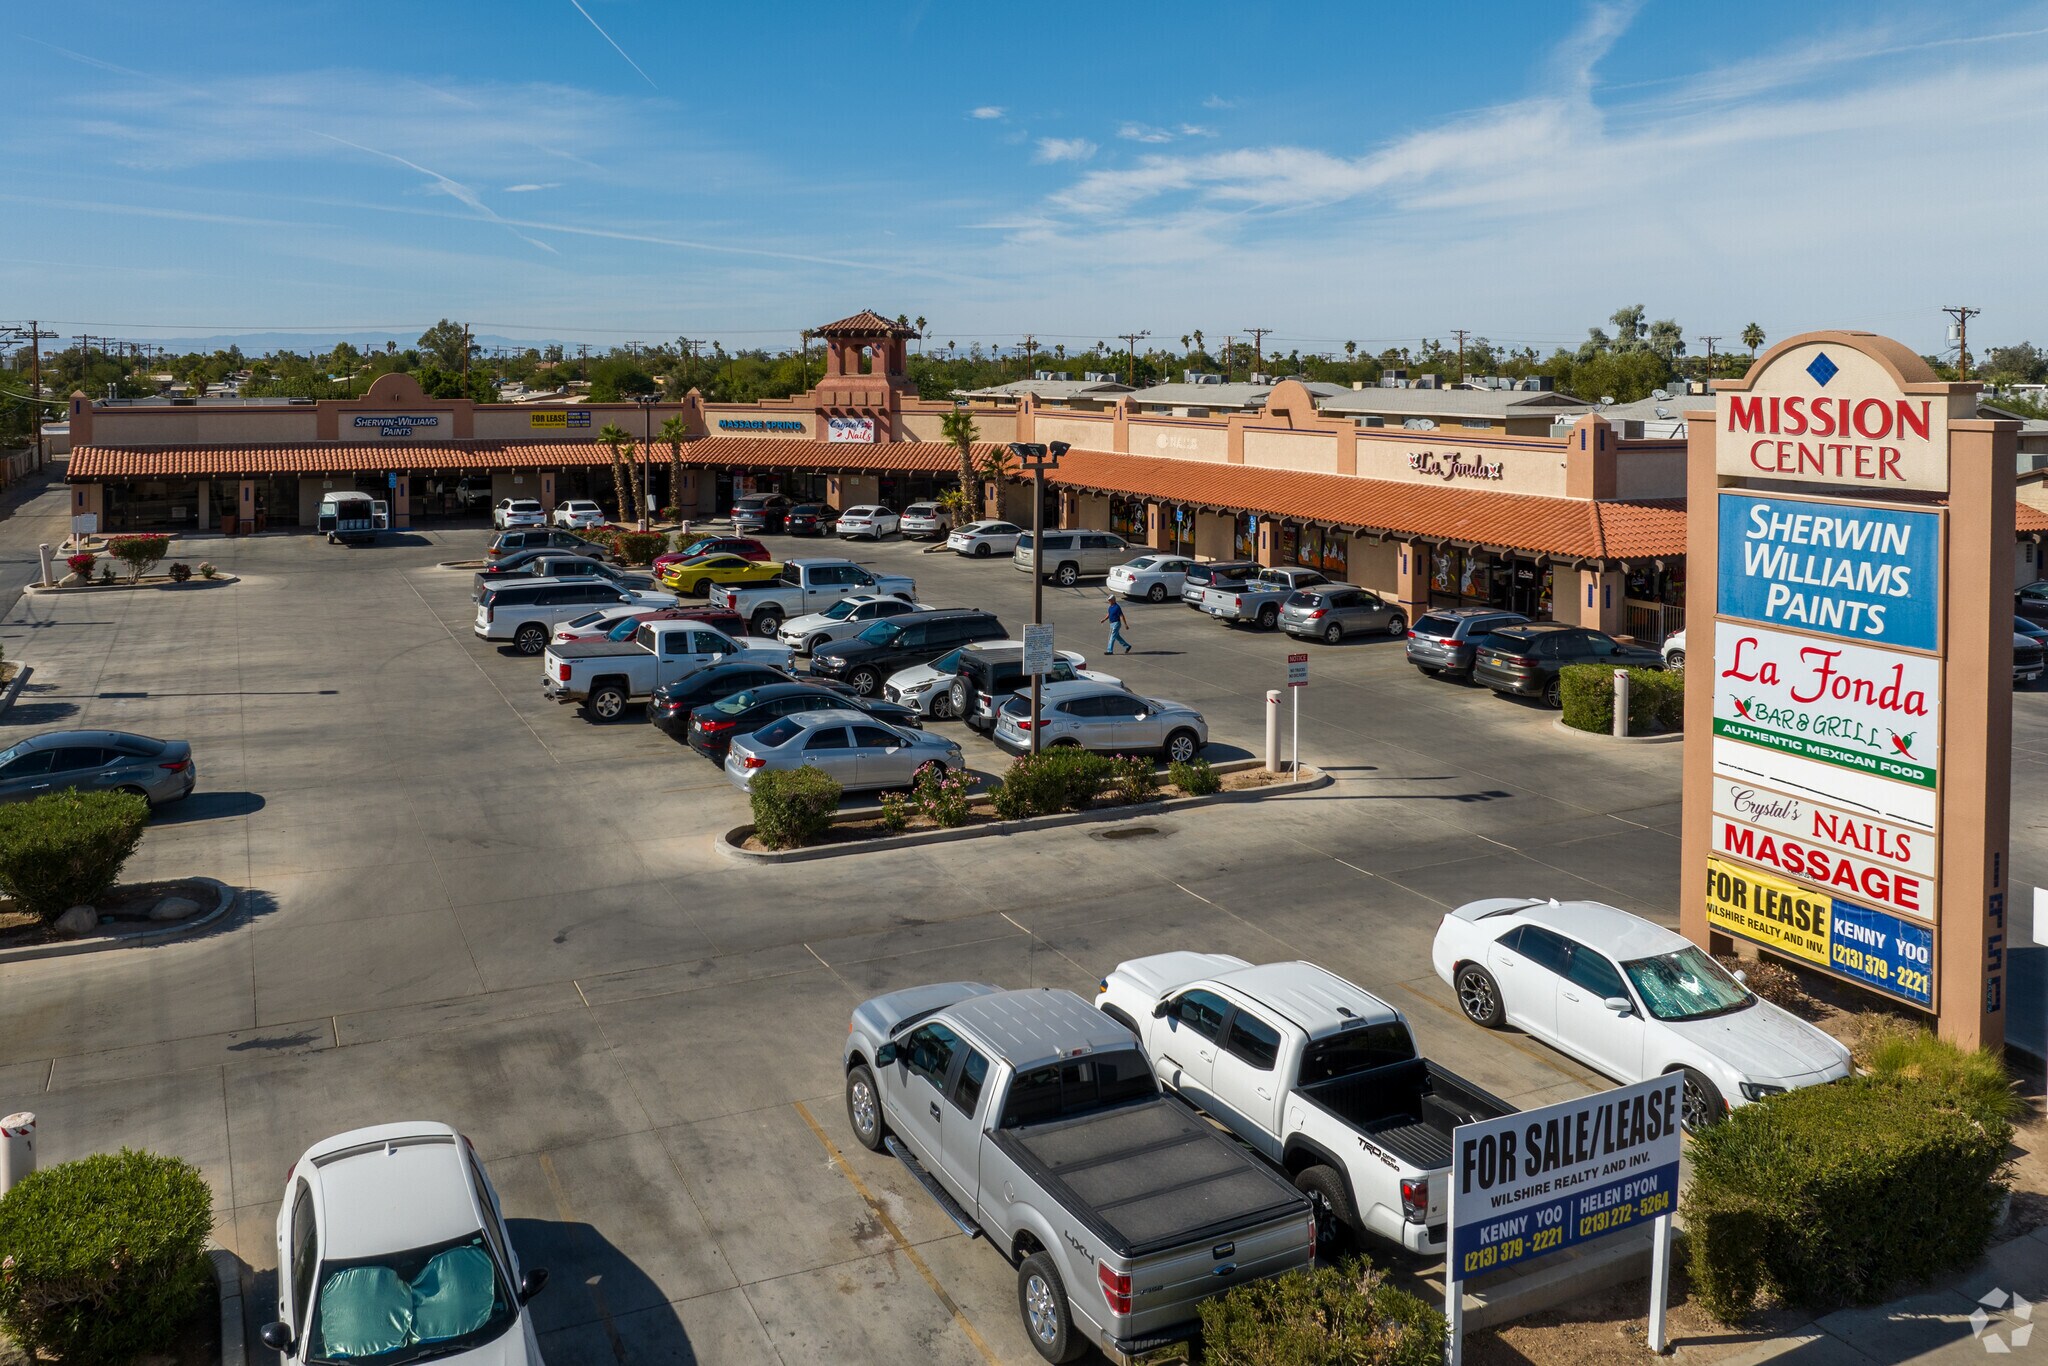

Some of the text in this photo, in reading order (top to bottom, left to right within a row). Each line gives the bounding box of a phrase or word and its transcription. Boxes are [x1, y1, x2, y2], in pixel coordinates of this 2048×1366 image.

[355, 417, 437, 427] SHERWIN-WILLIAMS
[382, 427, 411, 436] PAINTS
[532, 414, 545, 422] FOR
[546, 414, 566, 422] LEASE
[719, 419, 801, 430] MASSAGE SPRING
[845, 429, 872, 441] Nails
[1727, 395, 1931, 443] MISSION
[1416, 451, 1486, 479] La Fonda
[1749, 439, 1906, 481] CENTER
[1746, 504, 1911, 556] SHERWIN
[1744, 541, 1911, 597] WILLIAMS
[1765, 583, 1887, 636] PAINTS
[1721, 637, 1928, 717] La Fonda
[1755, 703, 1882, 749] BAR & GRILL
[1722, 724, 1925, 781] AUTHENTIC MEXICAN FOOD
[1730, 786, 1911, 863] Crystal's NAILS
[1724, 823, 1920, 911] MASSAGE
[1706, 868, 1826, 938] FOR LEASE
[1747, 917, 1781, 938] REALTY
[1783, 931, 1804, 947] AND
[1806, 938, 1825, 955] INV.
[1833, 917, 1929, 964] KENNY YOO
[1832, 942, 1863, 971] (213)
[1865, 954, 1888, 980] 379
[1897, 965, 1928, 995] 2221
[1357, 1136, 1382, 1158] TRD
[1462, 1085, 1676, 1195] FOR SALE/LEASE
[1380, 1156, 1400, 1172] ROAD
[1490, 1151, 1651, 1208] WILSHIRE REALTY AND INV.
[1580, 1174, 1658, 1215] HELEN BYON
[1580, 1210, 1610, 1237] (213)
[1611, 1203, 1632, 1227] 272
[1640, 1190, 1669, 1217] 5264
[1464, 1245, 1498, 1272] (213)
[1500, 1237, 1523, 1262] 379
[1532, 1225, 1563, 1252] 2221
[1480, 1205, 1563, 1245] KENNY YOO
